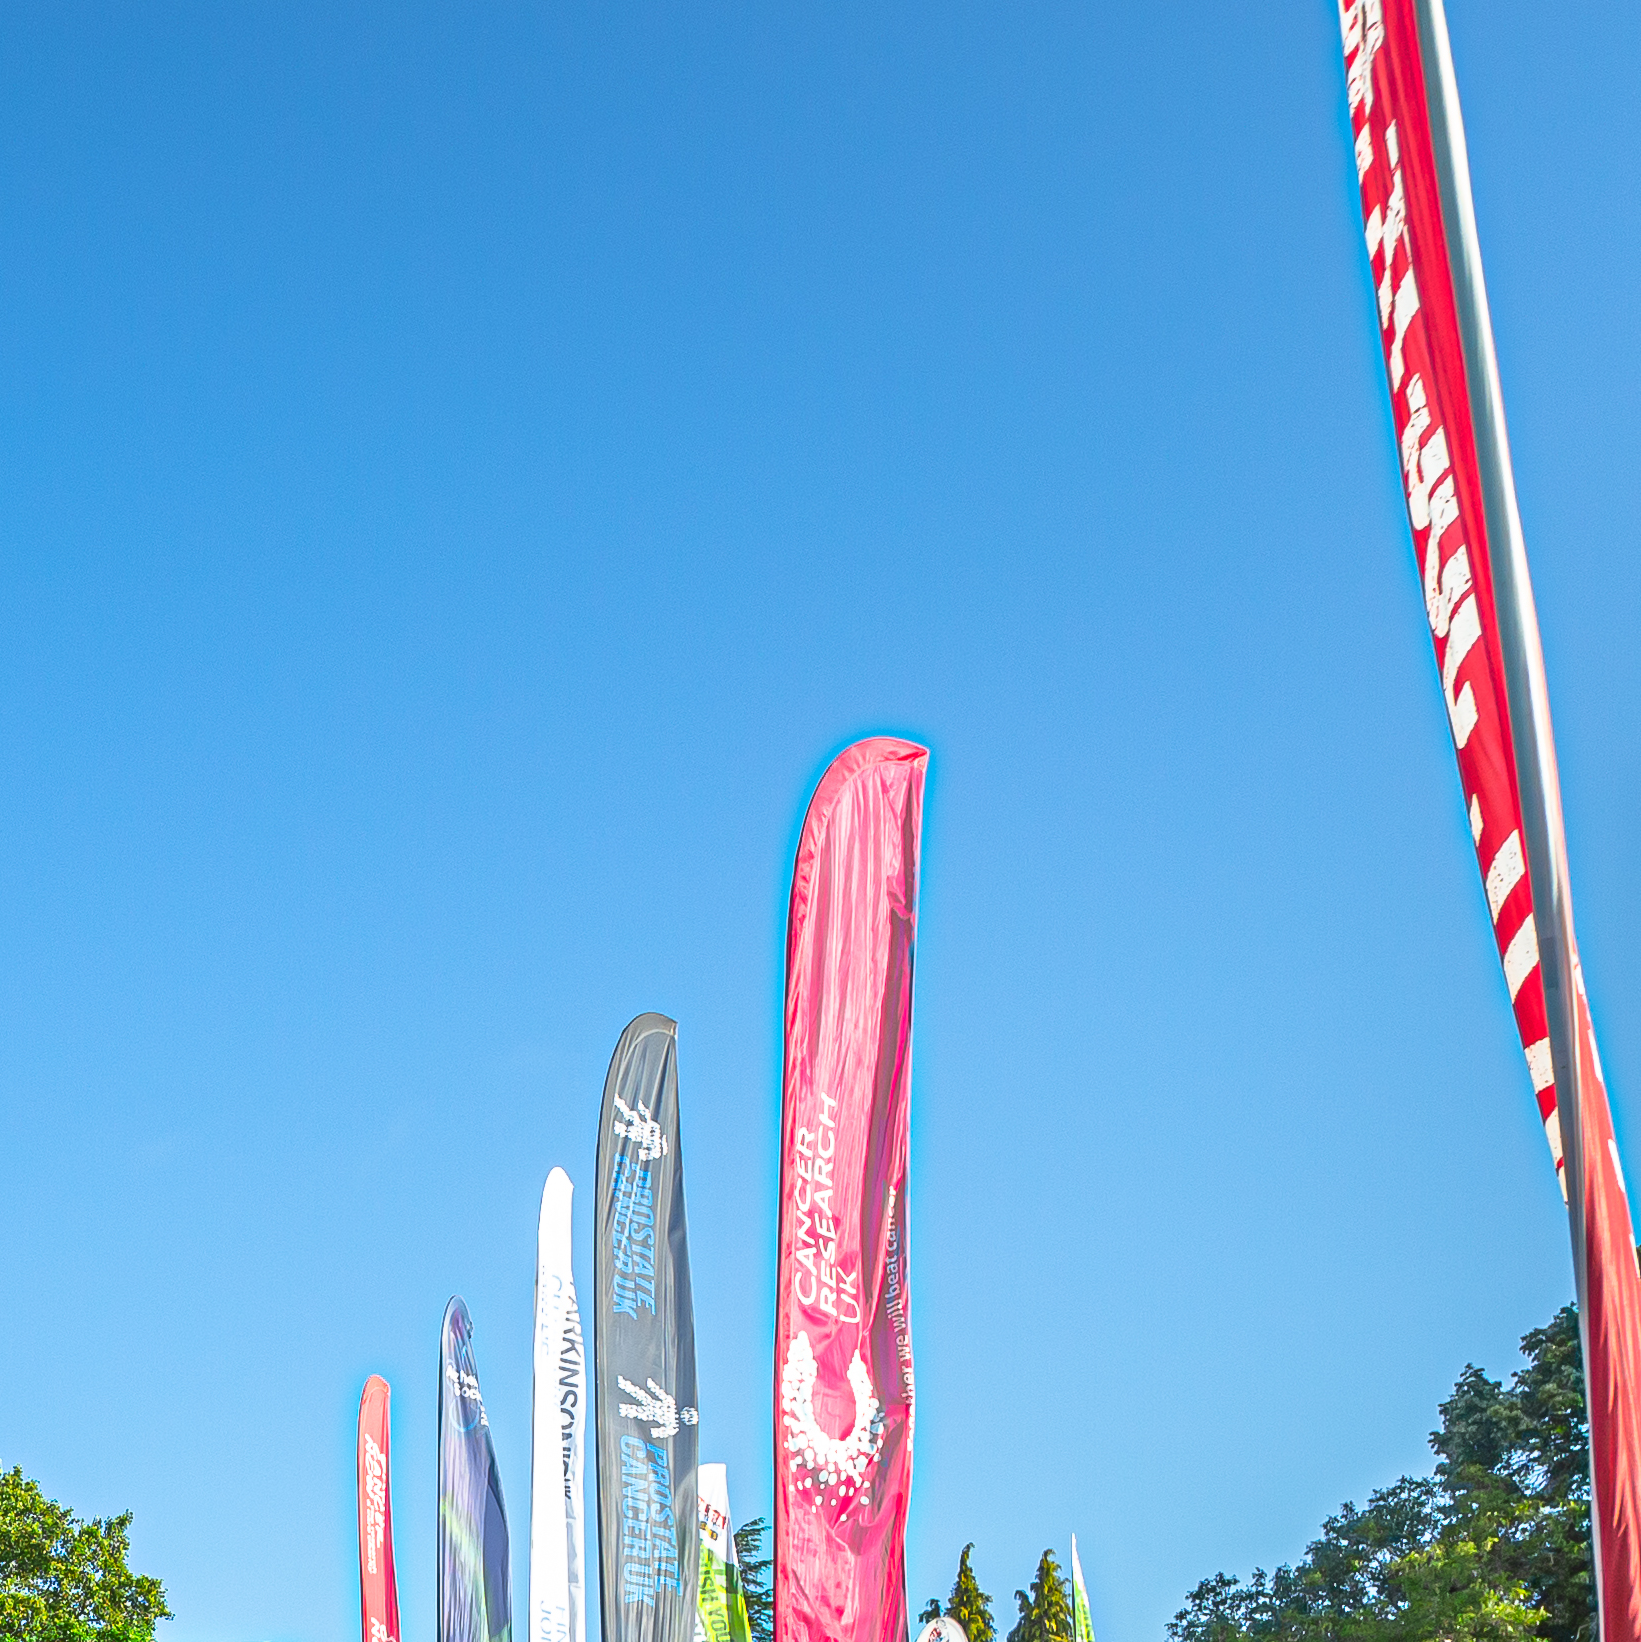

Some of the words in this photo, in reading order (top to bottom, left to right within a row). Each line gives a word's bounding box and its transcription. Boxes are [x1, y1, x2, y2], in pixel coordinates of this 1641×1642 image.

[629, 1162, 656, 1317] PROSTATE
[794, 1125, 818, 1307] CANCER
[813, 1091, 839, 1318] RESEARCH
[612, 1277, 639, 1320] UK
[839, 1270, 861, 1325] UK
[885, 1254, 901, 1297] beat
[619, 1434, 648, 1558] CANCER
[645, 1441, 683, 1598] PROSTATE
[622, 1562, 656, 1609] UK
